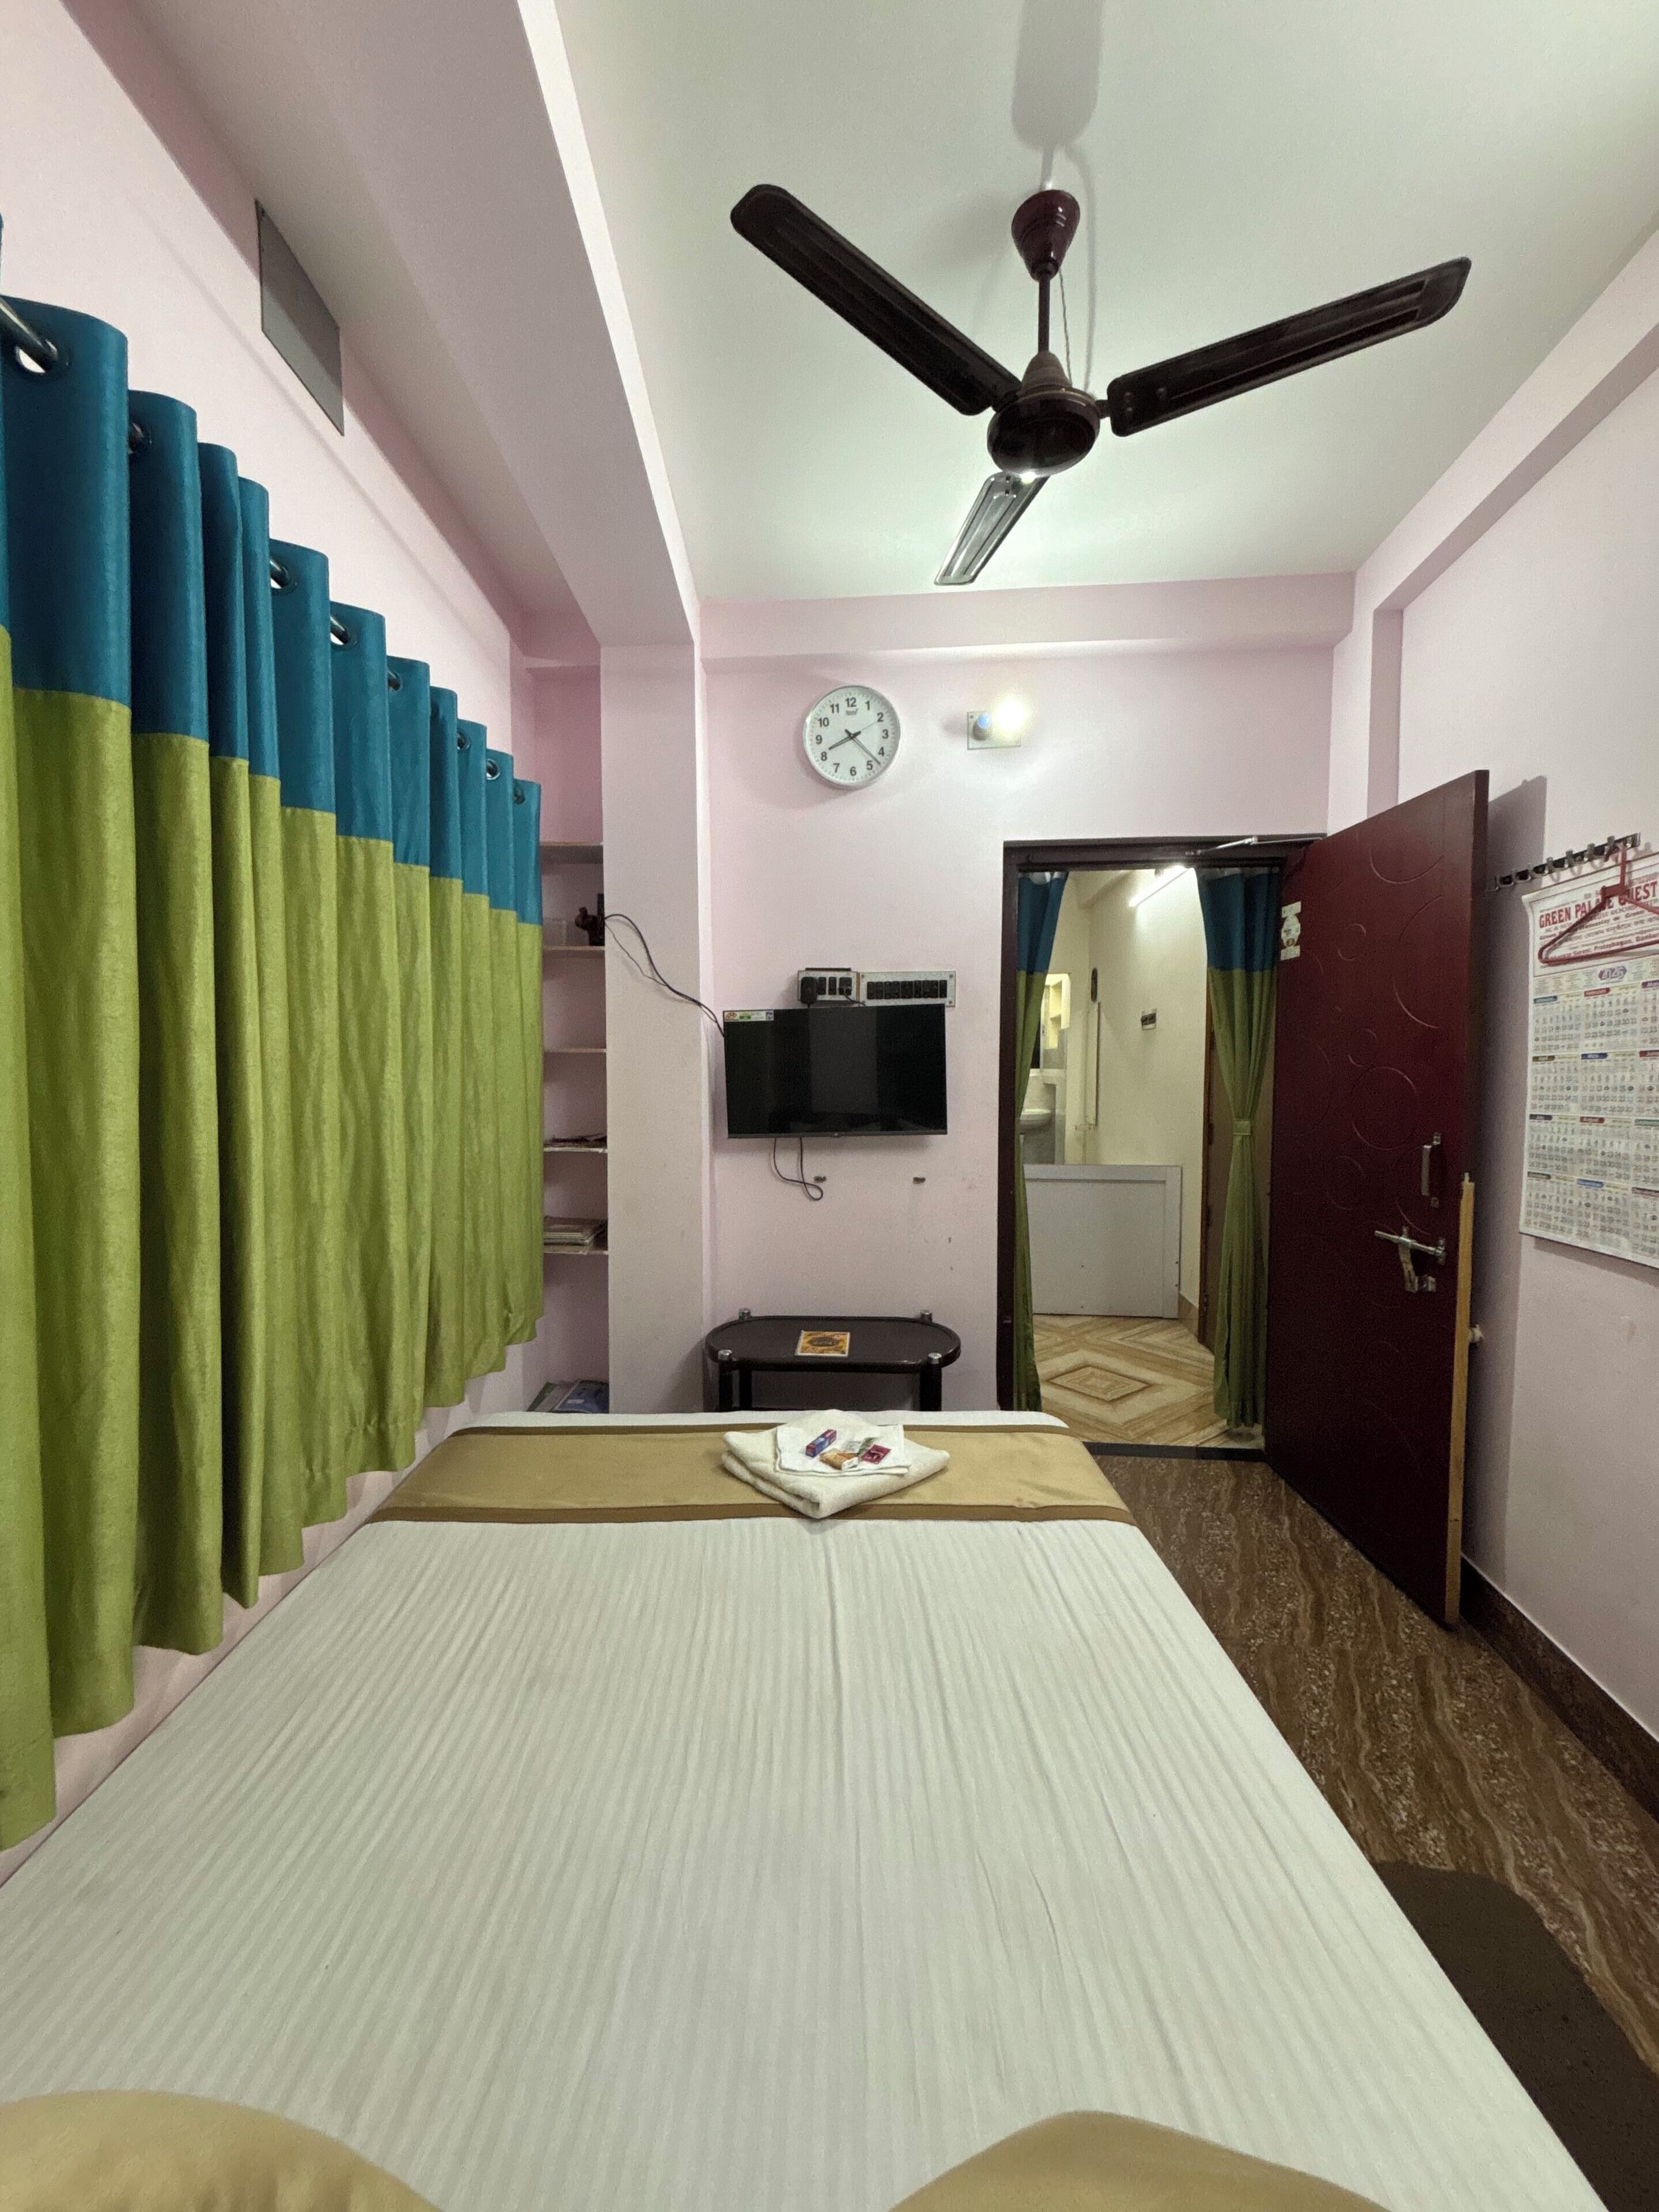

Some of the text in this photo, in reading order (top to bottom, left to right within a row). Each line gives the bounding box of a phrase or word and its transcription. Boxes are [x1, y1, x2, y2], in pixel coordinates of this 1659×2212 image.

[845, 697, 857, 707] 12
[865, 700, 870, 710] 1
[830, 703, 840, 714] 11
[817, 717, 830, 728] 10
[877, 713, 884, 722] 2
[815, 734, 823, 744] 9
[882, 729, 889, 739] 3
[820, 751, 828, 762] 8
[878, 747, 885, 756] 4
[832, 763, 840, 773] 7
[866, 760, 873, 770] 5
[850, 767, 857, 777] 6
[1539, 906, 1571, 929] GREEN
[1574, 896, 1614, 919] PALE
